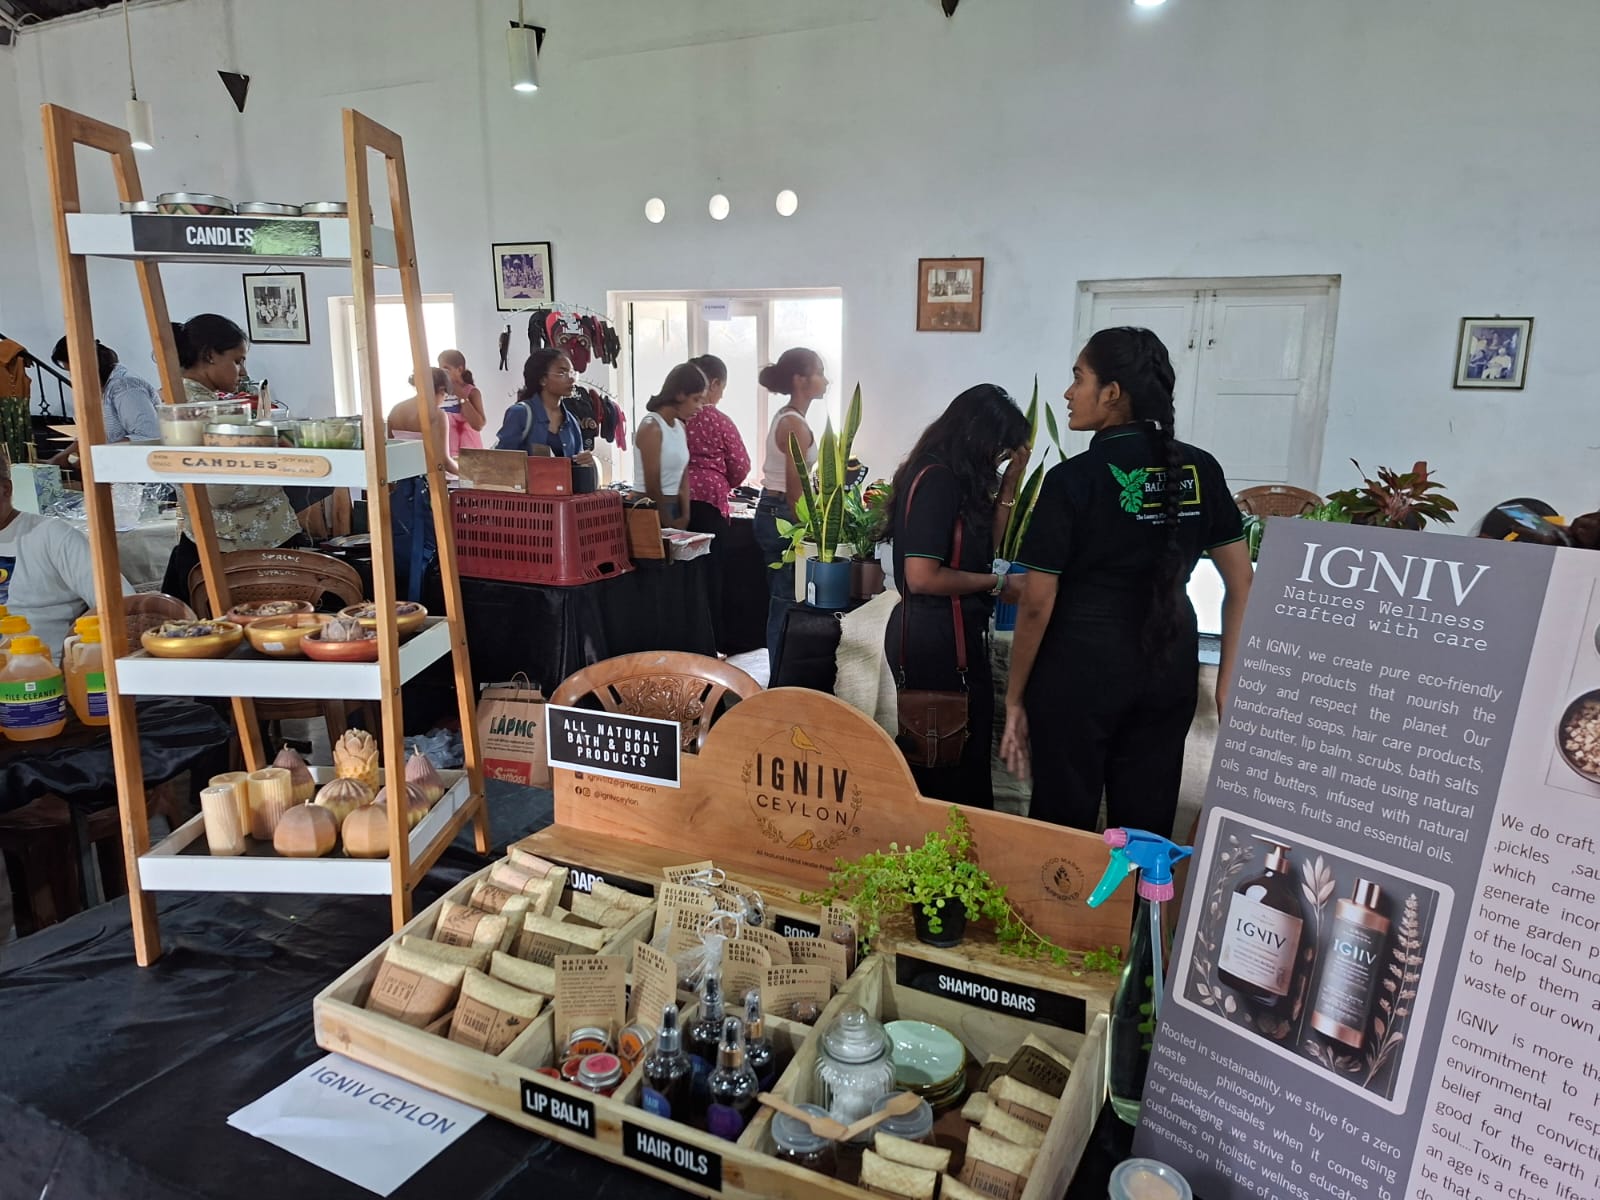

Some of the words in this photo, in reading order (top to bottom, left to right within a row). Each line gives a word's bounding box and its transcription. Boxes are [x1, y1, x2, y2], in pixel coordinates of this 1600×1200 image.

[186, 225, 255, 247] CANDLES
[182, 457, 278, 470] CANDLES
[1295, 542, 1491, 607] IGNIV
[1274, 603, 1356, 627] crafted
[1369, 619, 1419, 639] with
[1433, 631, 1488, 651] care
[1283, 585, 1365, 611] Natures
[1379, 600, 1486, 631] Wellness
[1243, 658, 1292, 677] wellness
[1301, 671, 1357, 692] products
[1369, 683, 1396, 701] that
[1406, 695, 1459, 715] nourish
[1472, 706, 1496, 724] the
[1247, 635, 1261, 649] At
[1308, 651, 1327, 663] we
[1332, 656, 1373, 673] create
[1379, 665, 1411, 680] pure
[1418, 673, 1503, 703] eco-friendly
[563, 718, 586, 733] ALL
[597, 723, 660, 744] NATURAL
[1234, 696, 1303, 724] handcrafted
[1351, 725, 1378, 743] hair
[1382, 736, 1412, 752] care
[1238, 676, 1267, 695] body
[1276, 688, 1300, 701] and
[1310, 695, 1358, 716] respect
[1369, 706, 1391, 723] the
[1463, 729, 1492, 748] Our
[567, 732, 600, 748] BATH
[608, 738, 616, 750] &
[624, 741, 659, 757] BODY
[577, 746, 647, 768] PRODUCTS
[1229, 716, 1257, 736] body
[1301, 735, 1316, 752] lip
[1408, 763, 1440, 784] bath
[1444, 776, 1480, 795] salts
[756, 752, 848, 803] IGNIV
[1220, 758, 1240, 772] oils
[1246, 766, 1269, 781] and
[1326, 789, 1375, 813] infused
[1382, 807, 1410, 824] with
[1418, 819, 1469, 843] natural
[1225, 739, 1247, 753] and
[1249, 745, 1294, 767] candles
[1297, 759, 1318, 773] are
[1321, 765, 1337, 779] all
[1340, 771, 1377, 791] made
[1381, 783, 1419, 807] using
[1423, 796, 1475, 819] natural
[756, 794, 847, 826] CEYLON
[1301, 802, 1333, 824] fruits
[1335, 817, 1361, 832] and
[1364, 826, 1424, 854] essential
[1500, 813, 1524, 832] We
[1530, 823, 1550, 840] do
[566, 869, 604, 892] OAP
[1483, 884, 1550, 915] generate
[1236, 918, 1287, 950] IGNIV
[1473, 929, 1490, 942] of
[1493, 933, 1517, 953] the
[1521, 944, 1558, 968] local
[1479, 904, 1521, 930] home
[1526, 924, 1582, 952] garden
[562, 958, 604, 966] NATURAL
[767, 967, 809, 976] NATURAL
[767, 974, 791, 982] BODY
[767, 979, 797, 987] SCRUB
[1469, 949, 1484, 966] to
[1494, 959, 1526, 984] help
[1539, 976, 1580, 1003] them
[938, 974, 999, 1003] SHAMPOO
[1001, 990, 1036, 1013] BARS
[1463, 974, 1506, 999] waste
[1510, 993, 1527, 1008] of
[1530, 1001, 1556, 1019] our
[1560, 1013, 1595, 1035] own
[310, 1066, 374, 1098] IGNIV
[368, 1091, 457, 1135] CEYLON
[525, 1088, 548, 1114] LIP
[551, 1097, 590, 1131] BALM
[1157, 1042, 1187, 1065] waste
[1216, 1075, 1276, 1115] philosophy
[1309, 1123, 1325, 1142] by
[1361, 1154, 1397, 1184] using
[1161, 1022, 1197, 1049] Rooted
[1198, 1042, 1208, 1056] in
[1285, 1090, 1302, 1106] we
[1305, 1101, 1338, 1125] strive
[1341, 1117, 1360, 1136] for
[1361, 1131, 1370, 1143] a
[1372, 1137, 1401, 1159] zero
[1145, 1098, 1198, 1135] customers
[1201, 1131, 1215, 1145] on
[1218, 1139, 1257, 1170] holistic
[1261, 1165, 1309, 1200] wellness
[1149, 1080, 1167, 1094] our
[1170, 1092, 1223, 1131] packaging
[1253, 1139, 1284, 1163] strive
[1291, 1159, 1302, 1174] to
[1153, 1061, 1265, 1131] recyclables/reusables
[1273, 1128, 1303, 1152] when
[1311, 1147, 1320, 1162] it
[1327, 1159, 1368, 1190] comes
[1378, 1185, 1391, 1200] to
[636, 1131, 672, 1162] HAIR
[674, 1148, 708, 1176] OILS
[1142, 1117, 1194, 1154] awareness
[1196, 1149, 1209, 1163] on
[1215, 1159, 1232, 1177] the
[1234, 1173, 1254, 1191] use
[1256, 1186, 1270, 1200] of
